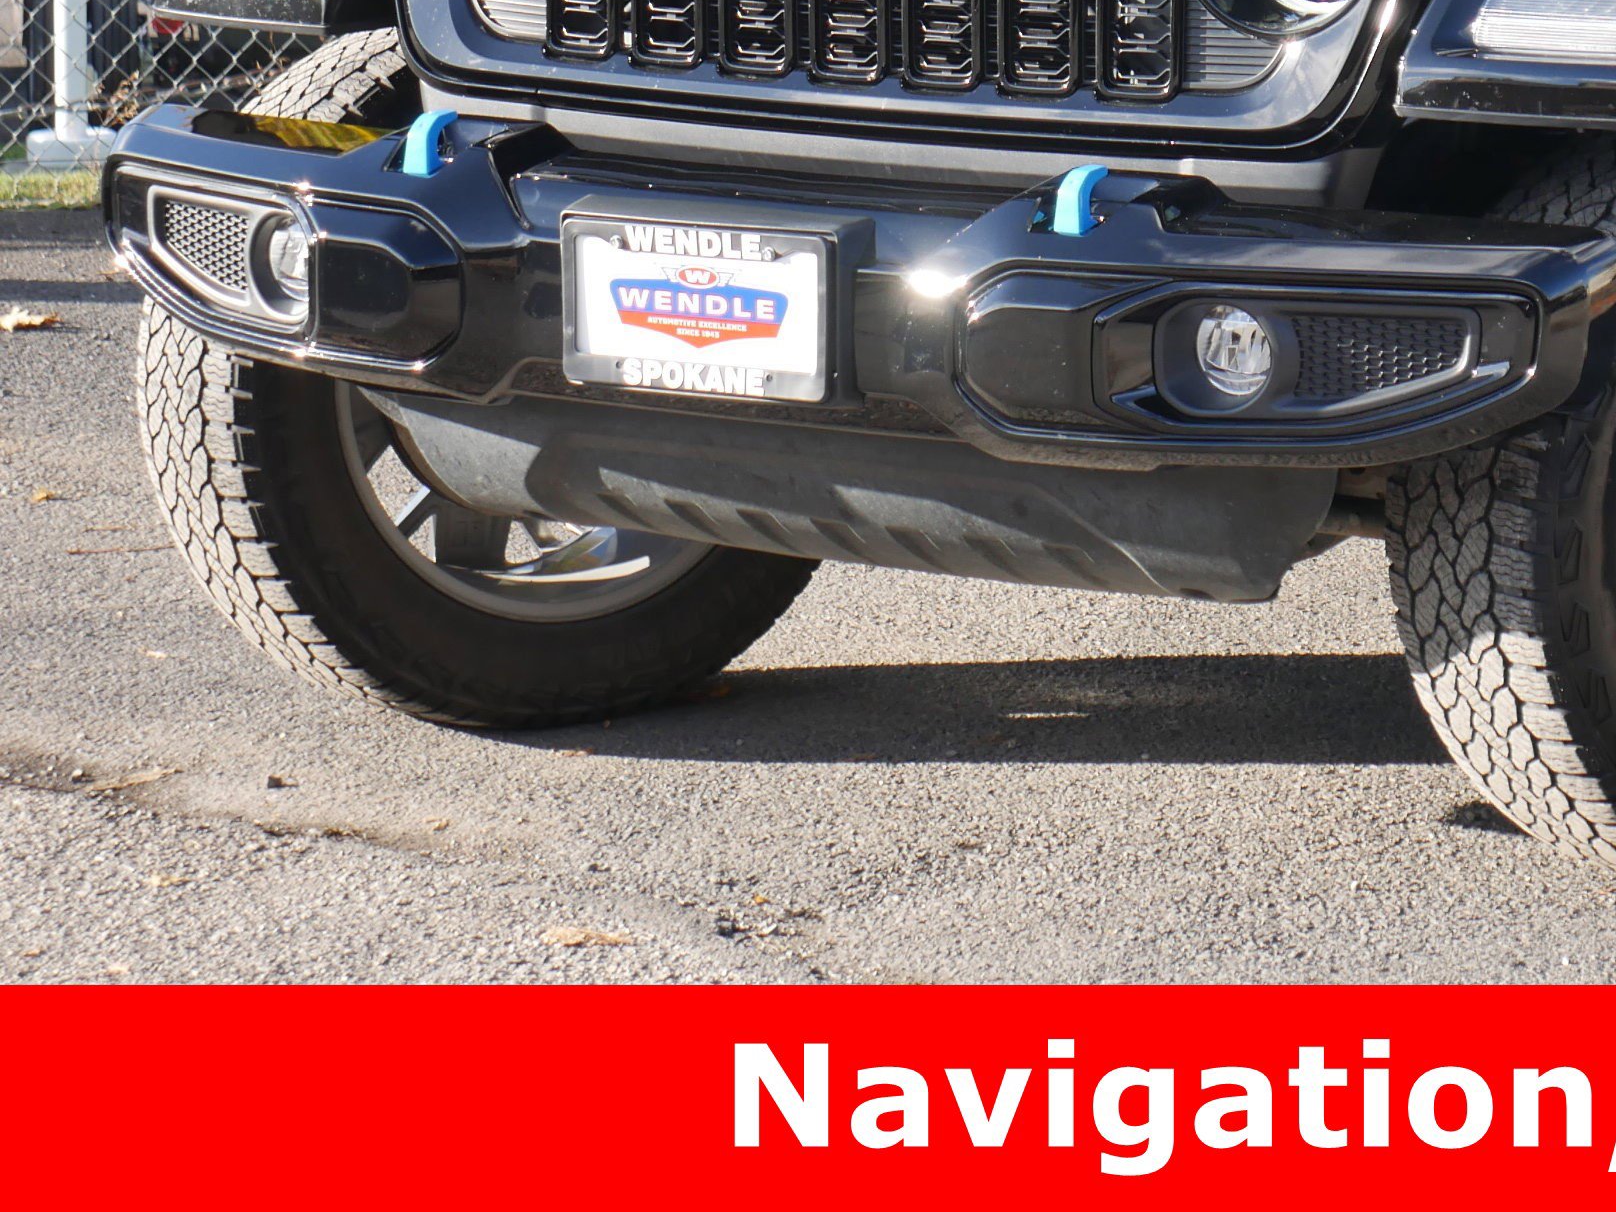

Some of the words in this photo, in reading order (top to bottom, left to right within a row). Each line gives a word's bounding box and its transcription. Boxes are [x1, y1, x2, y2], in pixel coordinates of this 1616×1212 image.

[625, 225, 763, 262] WENDLE
[618, 286, 775, 320] WENDLE
[647, 315, 697, 328] AUTOMOTIVE
[698, 320, 748, 333] EXCELLENCE
[676, 327, 700, 337] SINCE
[622, 357, 765, 396] SPOKANE
